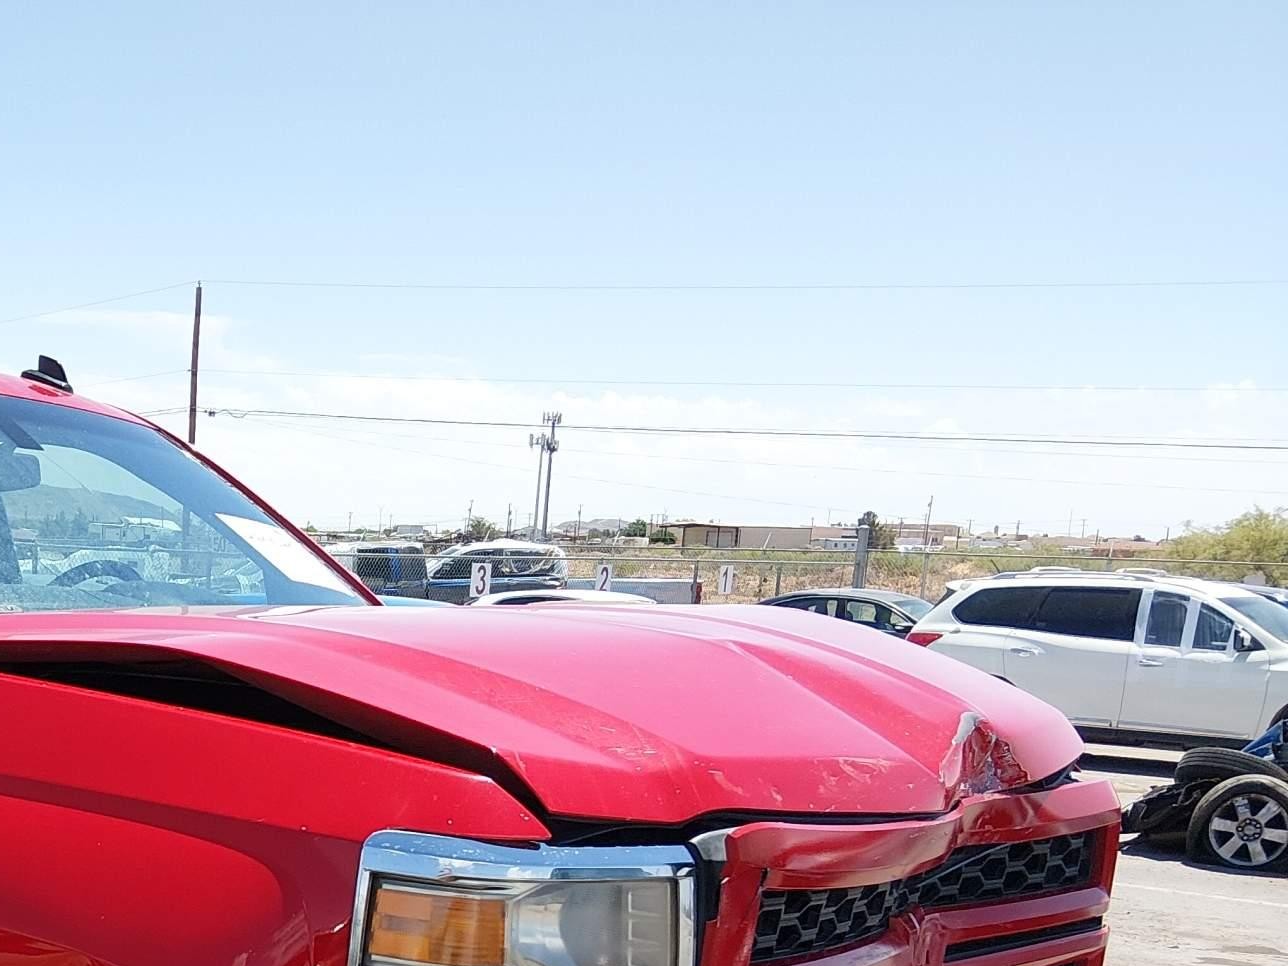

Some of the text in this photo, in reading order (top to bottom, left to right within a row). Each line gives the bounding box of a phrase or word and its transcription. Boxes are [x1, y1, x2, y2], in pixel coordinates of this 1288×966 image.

[474, 564, 487, 595] 3
[598, 566, 609, 591] 2
[722, 566, 729, 593] 1
